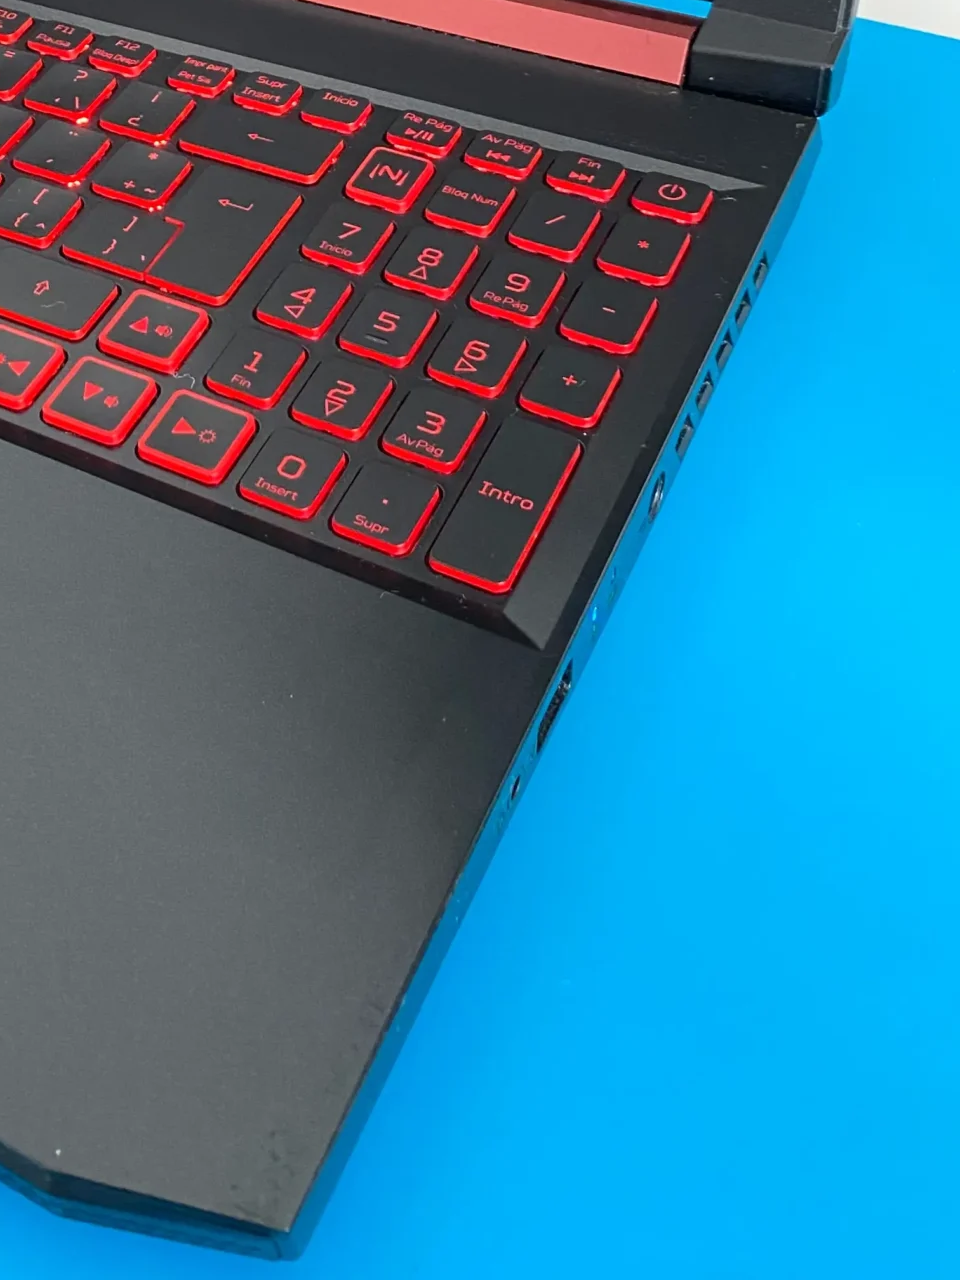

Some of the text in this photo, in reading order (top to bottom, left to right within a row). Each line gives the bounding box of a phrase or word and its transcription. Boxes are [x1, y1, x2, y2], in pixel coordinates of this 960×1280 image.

[54, 24, 75, 35] F11
[115, 39, 140, 51] F12
[256, 76, 288, 89] Supr
[242, 86, 281, 103] Insert
[322, 92, 359, 107] Inicio
[403, 112, 454, 133] Re Pág
[481, 134, 534, 154] Av Pág
[578, 157, 602, 170] Fin
[442, 185, 498, 207] Bloq Num
[337, 222, 361, 239] 7
[319, 240, 353, 257] Inicio
[417, 247, 444, 267] 8
[504, 273, 531, 293] 9
[290, 287, 316, 305] 4
[373, 311, 400, 332] 5
[463, 339, 491, 361] 6
[243, 351, 263, 373] 1
[230, 374, 252, 389] Fin
[327, 380, 356, 405] 2
[417, 411, 445, 435] 3
[277, 455, 306, 479] 0
[255, 477, 298, 501] Insert
[478, 480, 534, 510] Intro
[353, 514, 389, 534] Supr
